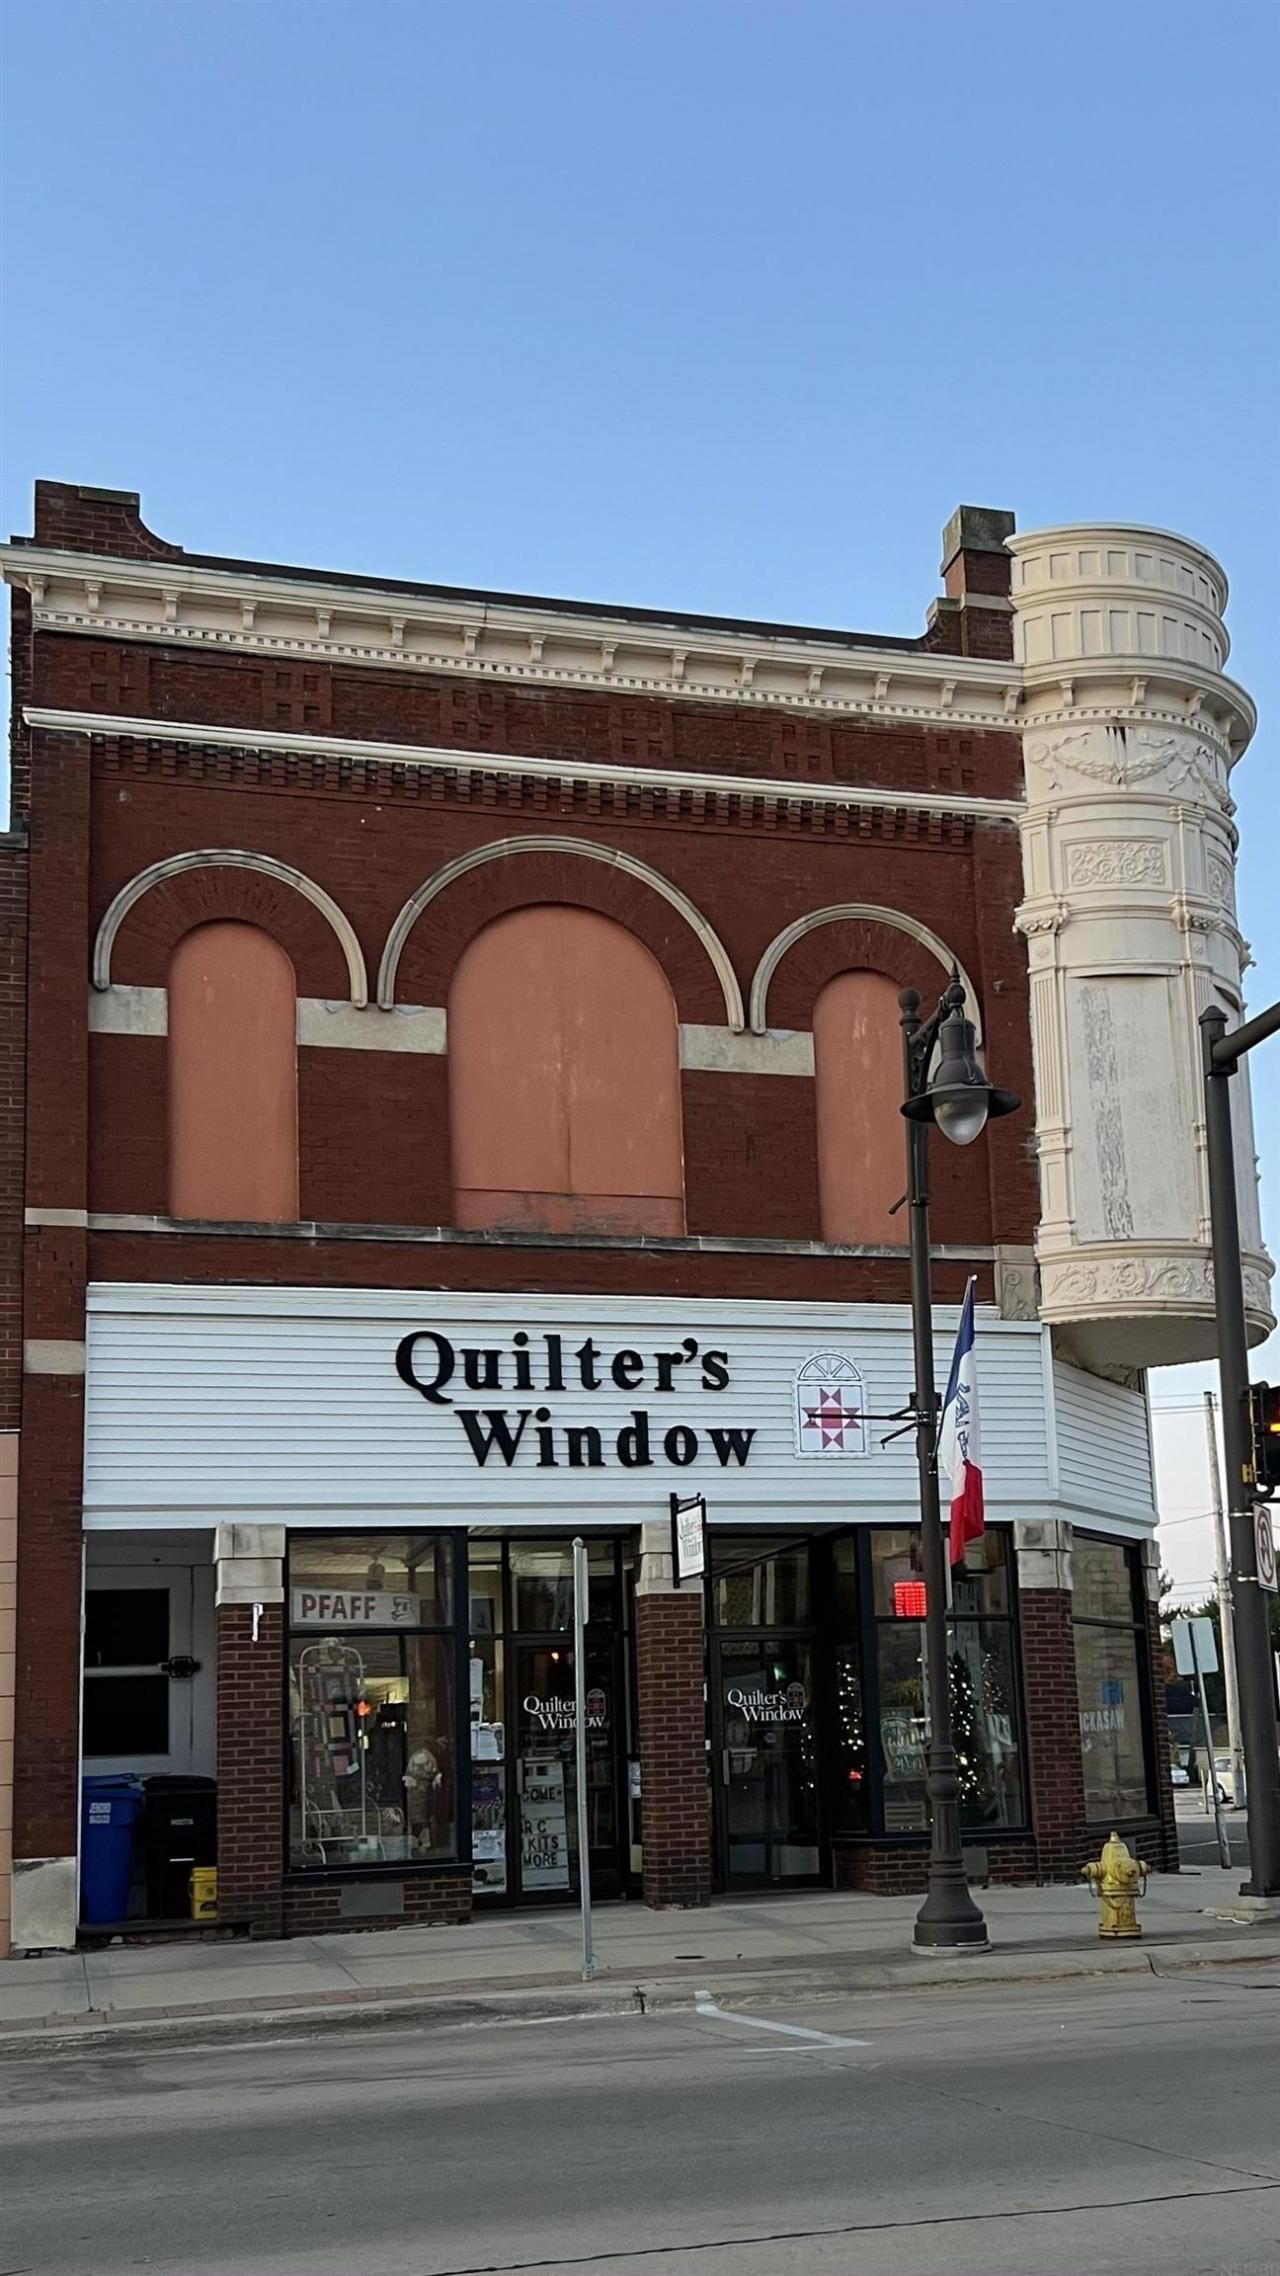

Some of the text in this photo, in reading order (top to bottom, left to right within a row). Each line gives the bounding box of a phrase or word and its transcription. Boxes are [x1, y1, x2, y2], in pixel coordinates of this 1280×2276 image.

[395, 1331, 730, 1404] Quilter's
[453, 1407, 758, 1467] Window
[301, 1593, 376, 1619] PFAFF
[727, 1688, 788, 1708] Quilter's
[741, 1704, 805, 1722] Window
[527, 1835, 559, 1851] KITS
[523, 1851, 558, 1868] MORE
